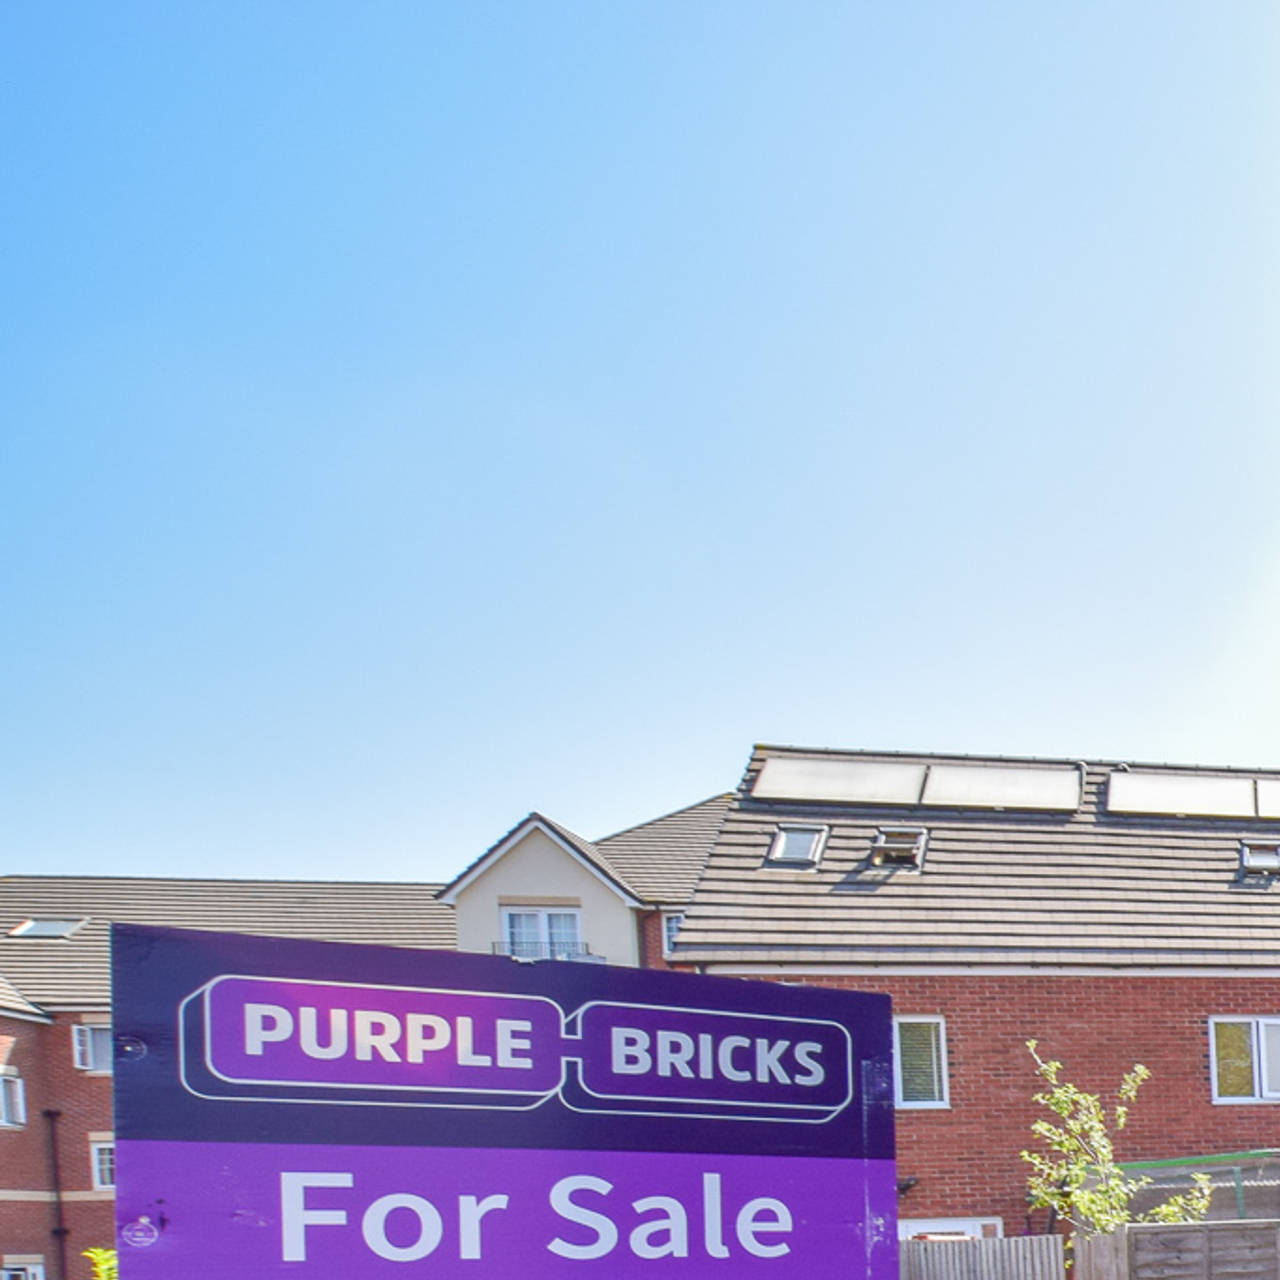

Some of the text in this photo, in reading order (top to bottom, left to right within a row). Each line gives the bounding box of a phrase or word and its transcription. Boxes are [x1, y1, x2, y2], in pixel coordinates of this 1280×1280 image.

[243, 1002, 826, 1087] PURPLE BRICKS
[280, 1171, 794, 1262] For Sale
